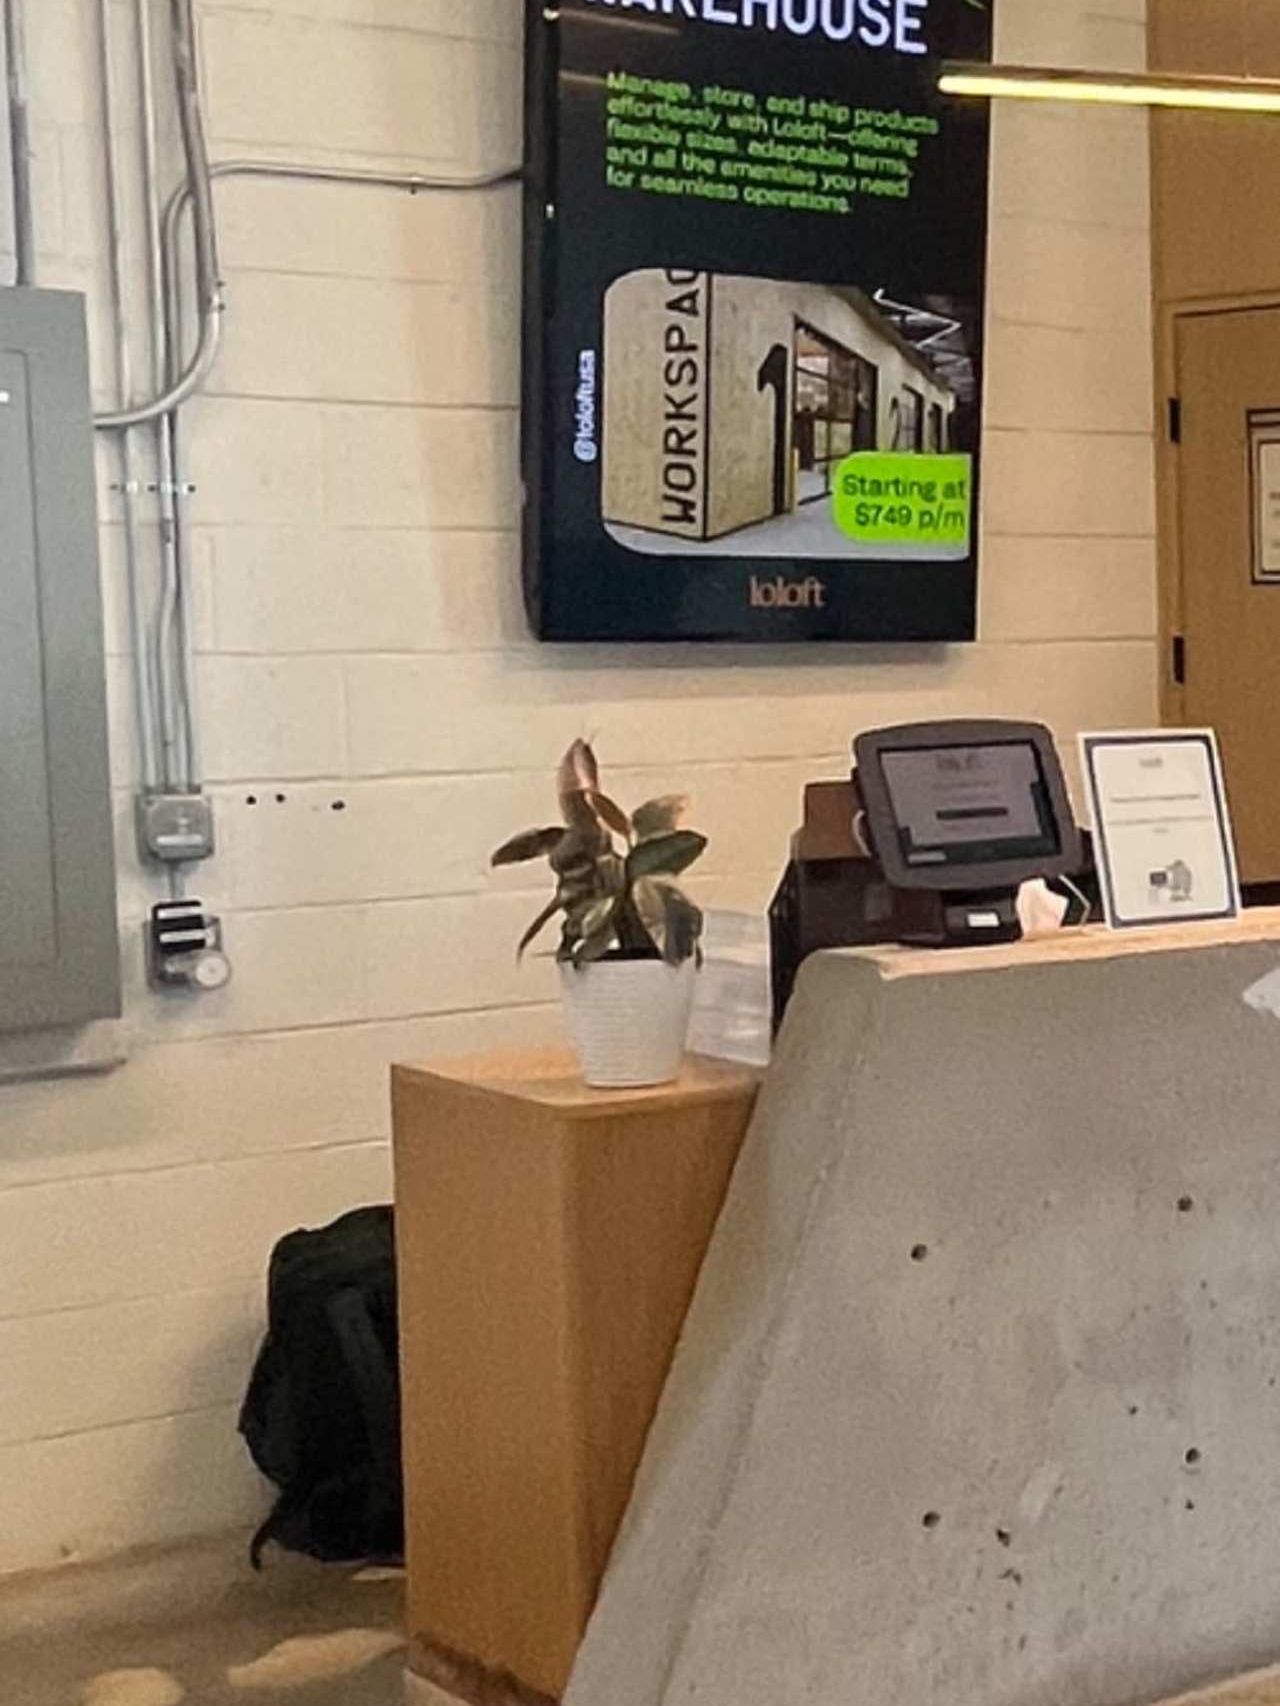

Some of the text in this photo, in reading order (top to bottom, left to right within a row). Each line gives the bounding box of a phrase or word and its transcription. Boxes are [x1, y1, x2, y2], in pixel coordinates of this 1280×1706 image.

[607, 95, 722, 131] effortlessly
[726, 108, 769, 134] with
[766, 96, 806, 115] and
[809, 99, 850, 124] ship
[854, 108, 939, 135] products
[606, 117, 682, 147] flexible
[747, 139, 850, 168] adaptable
[606, 146, 909, 198] and all the amenities you need
[606, 164, 635, 188] for
[639, 175, 740, 201] seamless
[574, 349, 597, 462] @loloftusa
[842, 474, 966, 504] Starting at
[854, 501, 966, 531] $749 p/m
[750, 576, 827, 608] loloft
